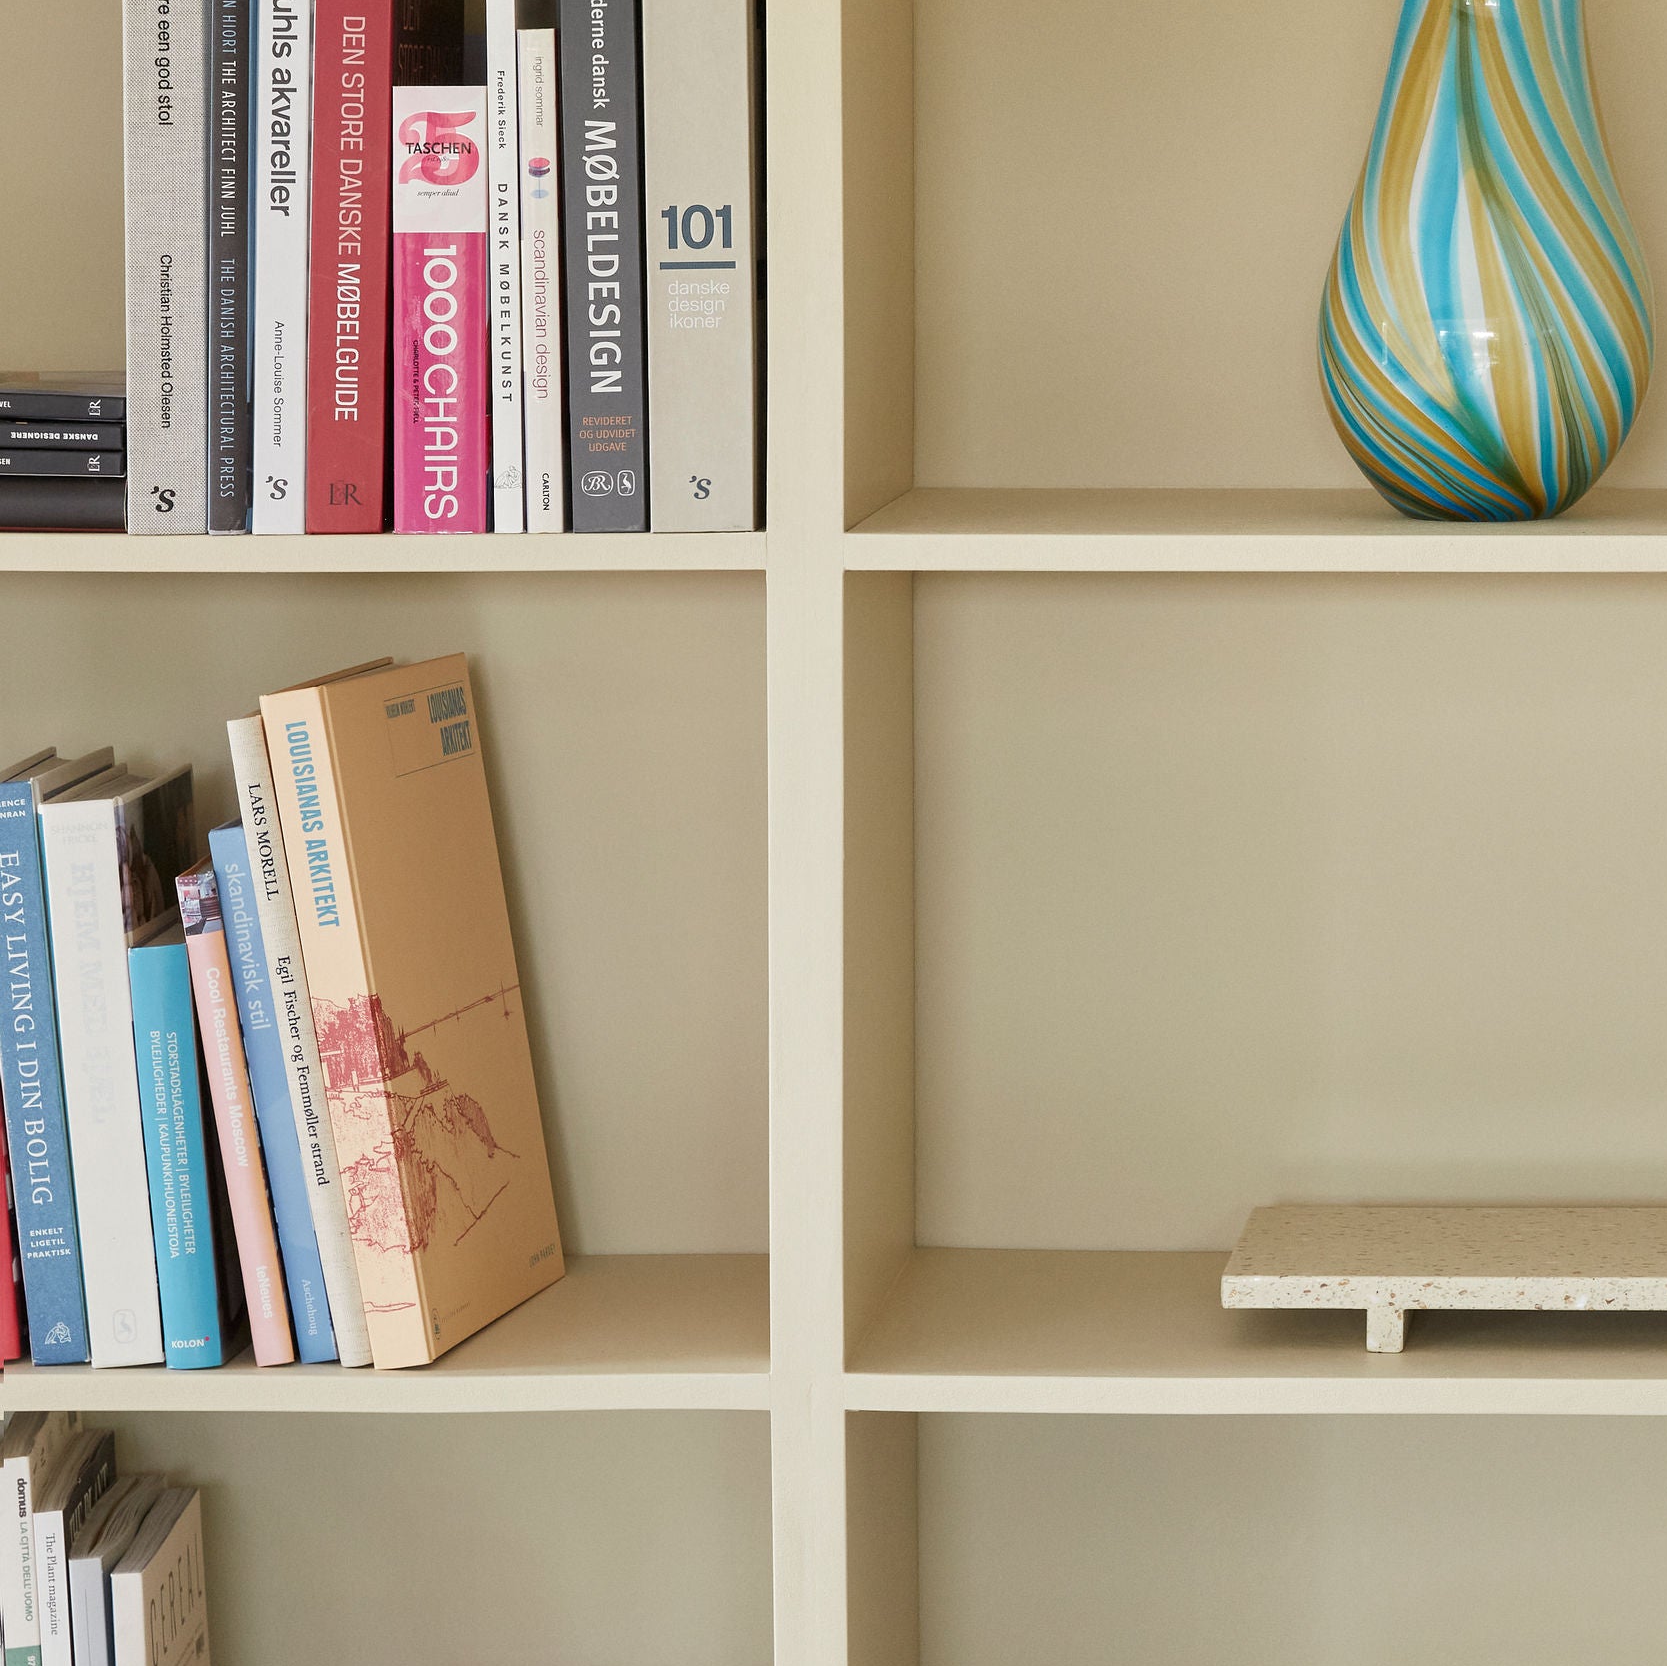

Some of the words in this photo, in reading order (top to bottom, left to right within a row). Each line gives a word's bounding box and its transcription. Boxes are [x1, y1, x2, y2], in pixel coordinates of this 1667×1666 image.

[157, 21, 171, 52] een
[222, 14, 237, 55] HIORT
[342, 15, 366, 65] DEN
[155, 56, 174, 90] god
[222, 60, 236, 85] THE
[497, 70, 506, 116] Frederik
[533, 55, 545, 84] ingrid
[591, 52, 611, 110] dansk
[157, 95, 174, 126] stol
[221, 90, 236, 162] ARCHITECT
[340, 72, 365, 151] STORE
[535, 86, 545, 127] sommar
[270, 68, 298, 217] akvareller
[405, 142, 472, 155] TASCHEN
[497, 119, 506, 149] Sieck
[221, 169, 236, 199] FINN
[220, 203, 235, 238] JUHL
[338, 159, 364, 257] DANSKE
[497, 182, 509, 250] DANSK
[661, 204, 732, 251] 101
[220, 258, 235, 283] THE
[581, 119, 622, 394] MØBELDESIGN
[159, 254, 174, 313] Christian
[423, 244, 459, 356] 1000
[533, 229, 550, 339] scandinavian
[668, 279, 730, 296] danske
[668, 296, 726, 316] design
[220, 287, 235, 338] DANISH
[499, 263, 513, 403] MØBELKUNST
[669, 314, 722, 329] ikoner
[160, 316, 174, 379] Holmsted
[273, 320, 285, 395] Anne-Louise
[334, 263, 361, 422] MØBELGUIDE
[532, 343, 550, 400] design
[160, 382, 174, 429] Olesen
[220, 344, 235, 451] ARCHITECTURAL
[10, 431, 61, 440] DESIGNERE
[63, 432, 99, 441] DANSKE
[273, 397, 285, 448] Sommer
[423, 363, 459, 520] CHAIRS
[579, 429, 595, 439] OG
[595, 428, 636, 439] UDVIDET
[582, 416, 633, 427] REVIDERET
[588, 442, 627, 453] UDGAVE
[219, 456, 235, 499] PRESS
[541, 472, 550, 512] CARLTON
[248, 782, 267, 827] LARS
[285, 720, 325, 834] LOUISIANAS
[305, 838, 340, 928] ARKITEKT
[0, 849, 26, 925] EASY
[256, 830, 280, 901] MORELL
[224, 863, 258, 995] skandinavisk
[248, 999, 272, 1031] stil
[275, 955, 294, 985] Egil
[6, 933, 36, 1033] LIVING
[205, 966, 225, 1000] Cool
[282, 989, 302, 1043] Fischer
[16, 1042, 37, 1052] I
[212, 1000, 237, 1101] Restaurants
[290, 1044, 304, 1064] og
[18, 1060, 44, 1110] DIN
[295, 1064, 320, 1141] Femmøller
[227, 1103, 249, 1168] Moscow
[24, 1119, 54, 1206] BOLIG
[310, 1141, 330, 1187] strand
[27, 1248, 72, 1260] PRAKTISK
[29, 1227, 64, 1237] ENKELT
[30, 1238, 66, 1249] LIGETIL
[255, 1265, 273, 1320] teNeues
[301, 1278, 318, 1337] Aschehoug
[171, 1338, 205, 1350] KOLON
[45, 1533, 56, 1554] The
[46, 1555, 58, 1582] Plant
[46, 1583, 59, 1636] magazine
